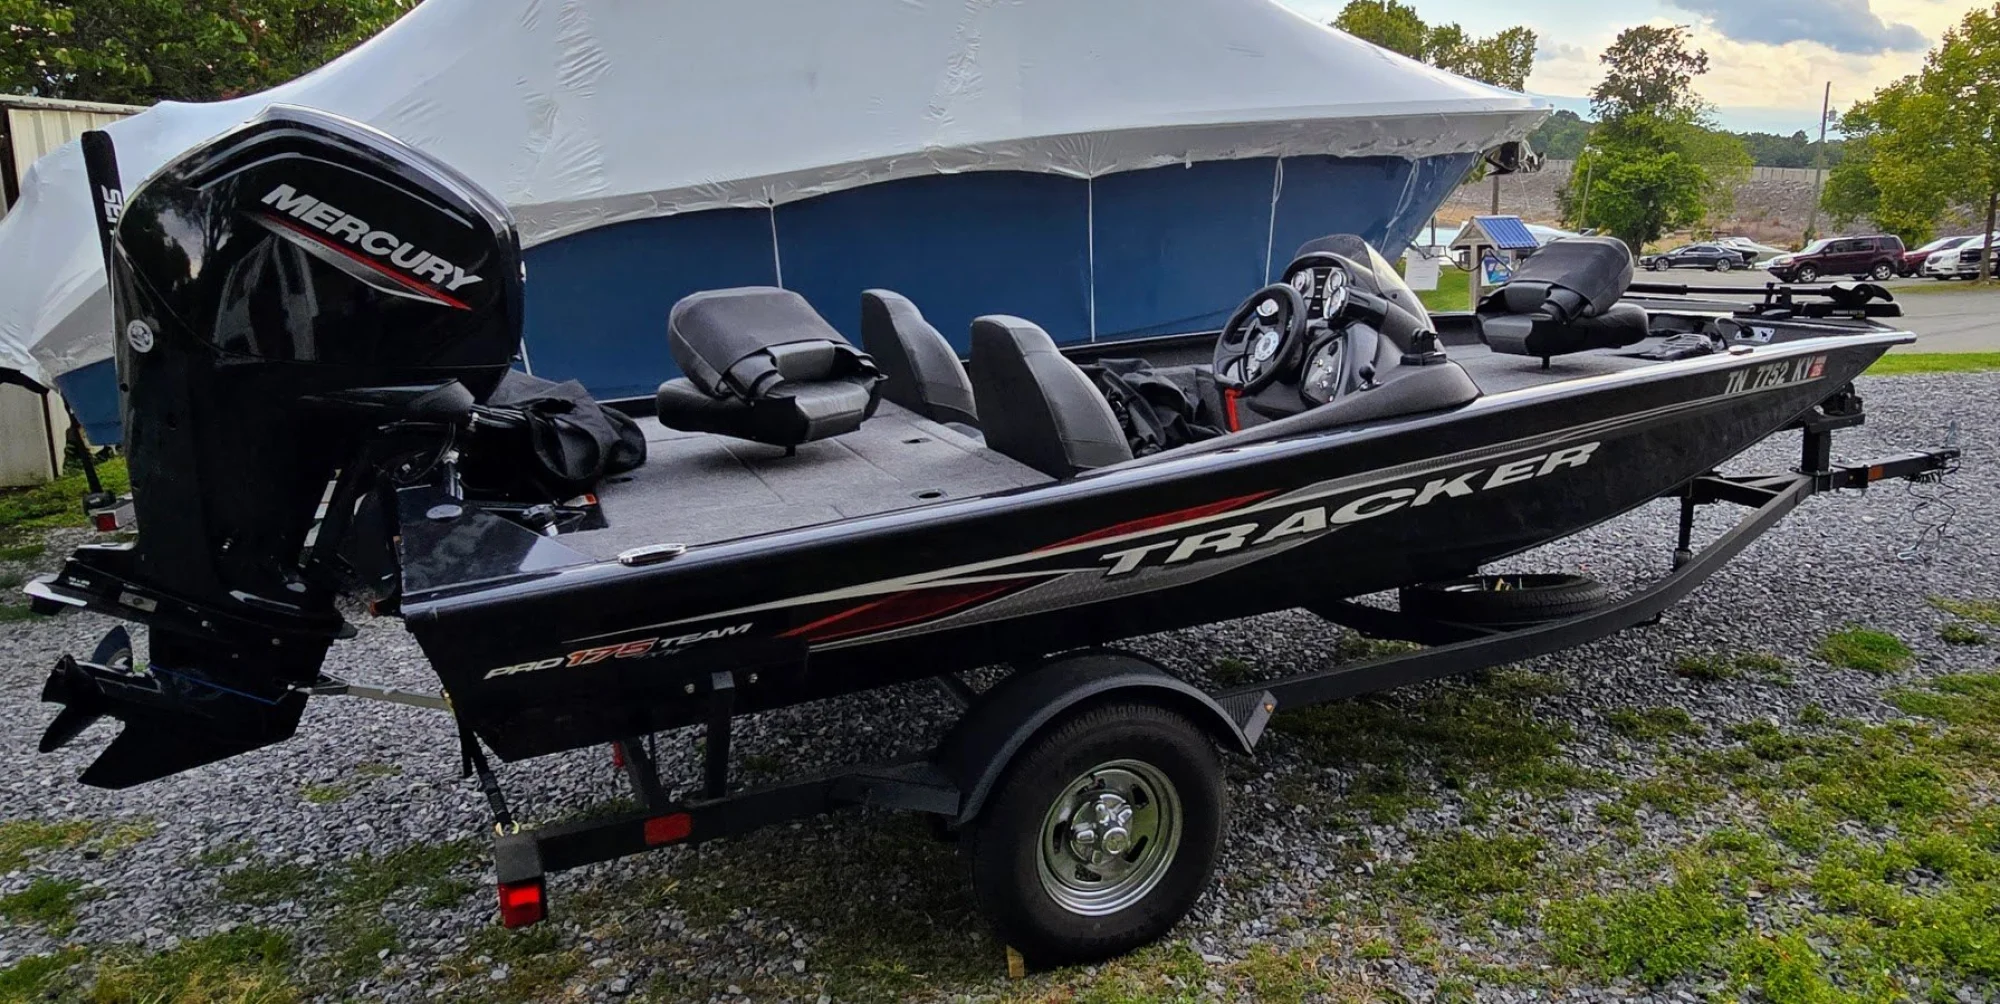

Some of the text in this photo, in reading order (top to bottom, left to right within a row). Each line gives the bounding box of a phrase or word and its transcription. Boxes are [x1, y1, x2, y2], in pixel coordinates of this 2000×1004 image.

[260, 183, 483, 291] MERCURY
[1724, 368, 1750, 394] TN
[1752, 360, 1790, 389] 7752
[1791, 355, 1817, 381] KY
[1099, 441, 1600, 576] TRACKER
[484, 656, 565, 680] PRO
[564, 637, 660, 668] 175
[660, 622, 754, 647] TEAM
